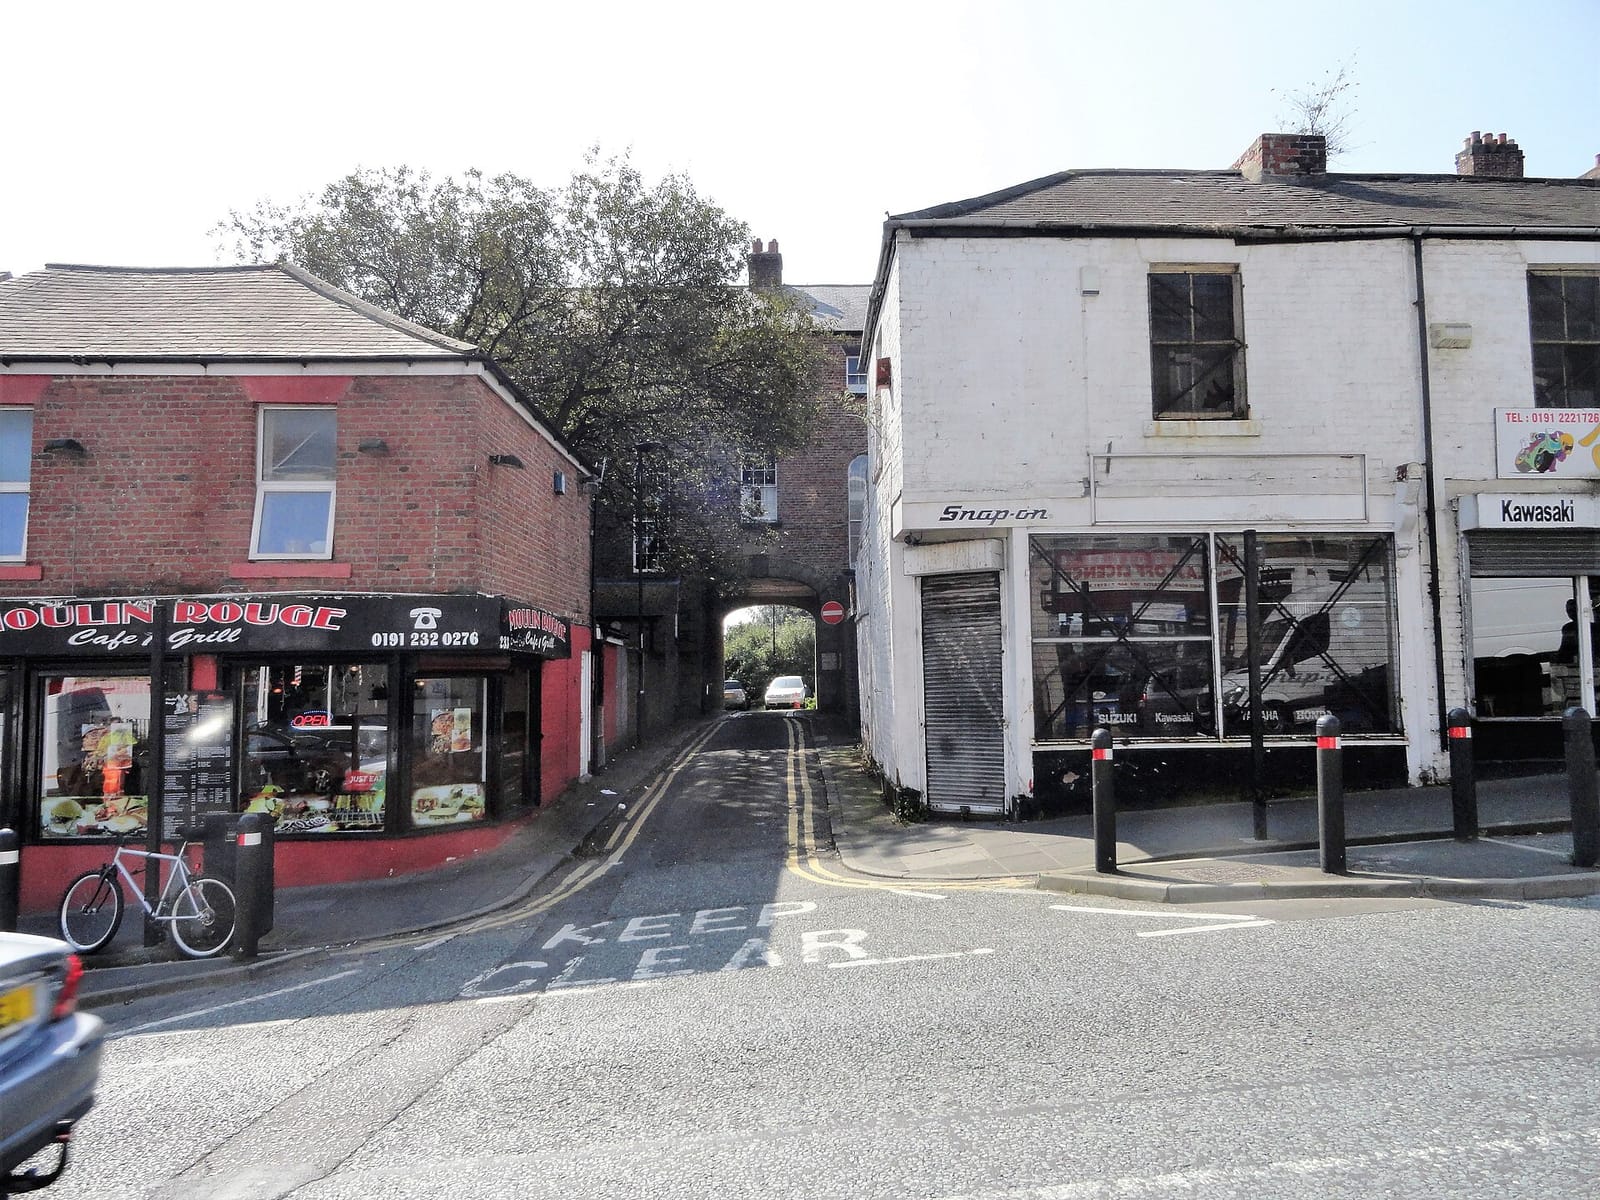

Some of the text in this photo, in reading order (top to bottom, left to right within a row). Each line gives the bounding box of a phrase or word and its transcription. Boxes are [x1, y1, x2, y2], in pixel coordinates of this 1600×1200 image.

[1531, 412, 1555, 423] 0191
[1558, 412, 1600, 424] 2221726
[939, 505, 1048, 526] Snap-on
[1501, 499, 1575, 522] Kawasaki
[0, 601, 347, 632] OULIN ROUGE
[508, 608, 541, 632] MOULIN
[67, 628, 138, 650] Cafe
[168, 628, 242, 650] Grill
[371, 631, 479, 647] 0191 232 0276
[293, 715, 330, 726] OPEN
[1098, 713, 1137, 724] SUZUKI
[1155, 712, 1194, 723] Kawasaki
[1240, 710, 1279, 720] YAAHA
[350, 775, 382, 784] JUST EAT
[542, 900, 818, 950] KEEP
[459, 928, 870, 999] CLEAR
